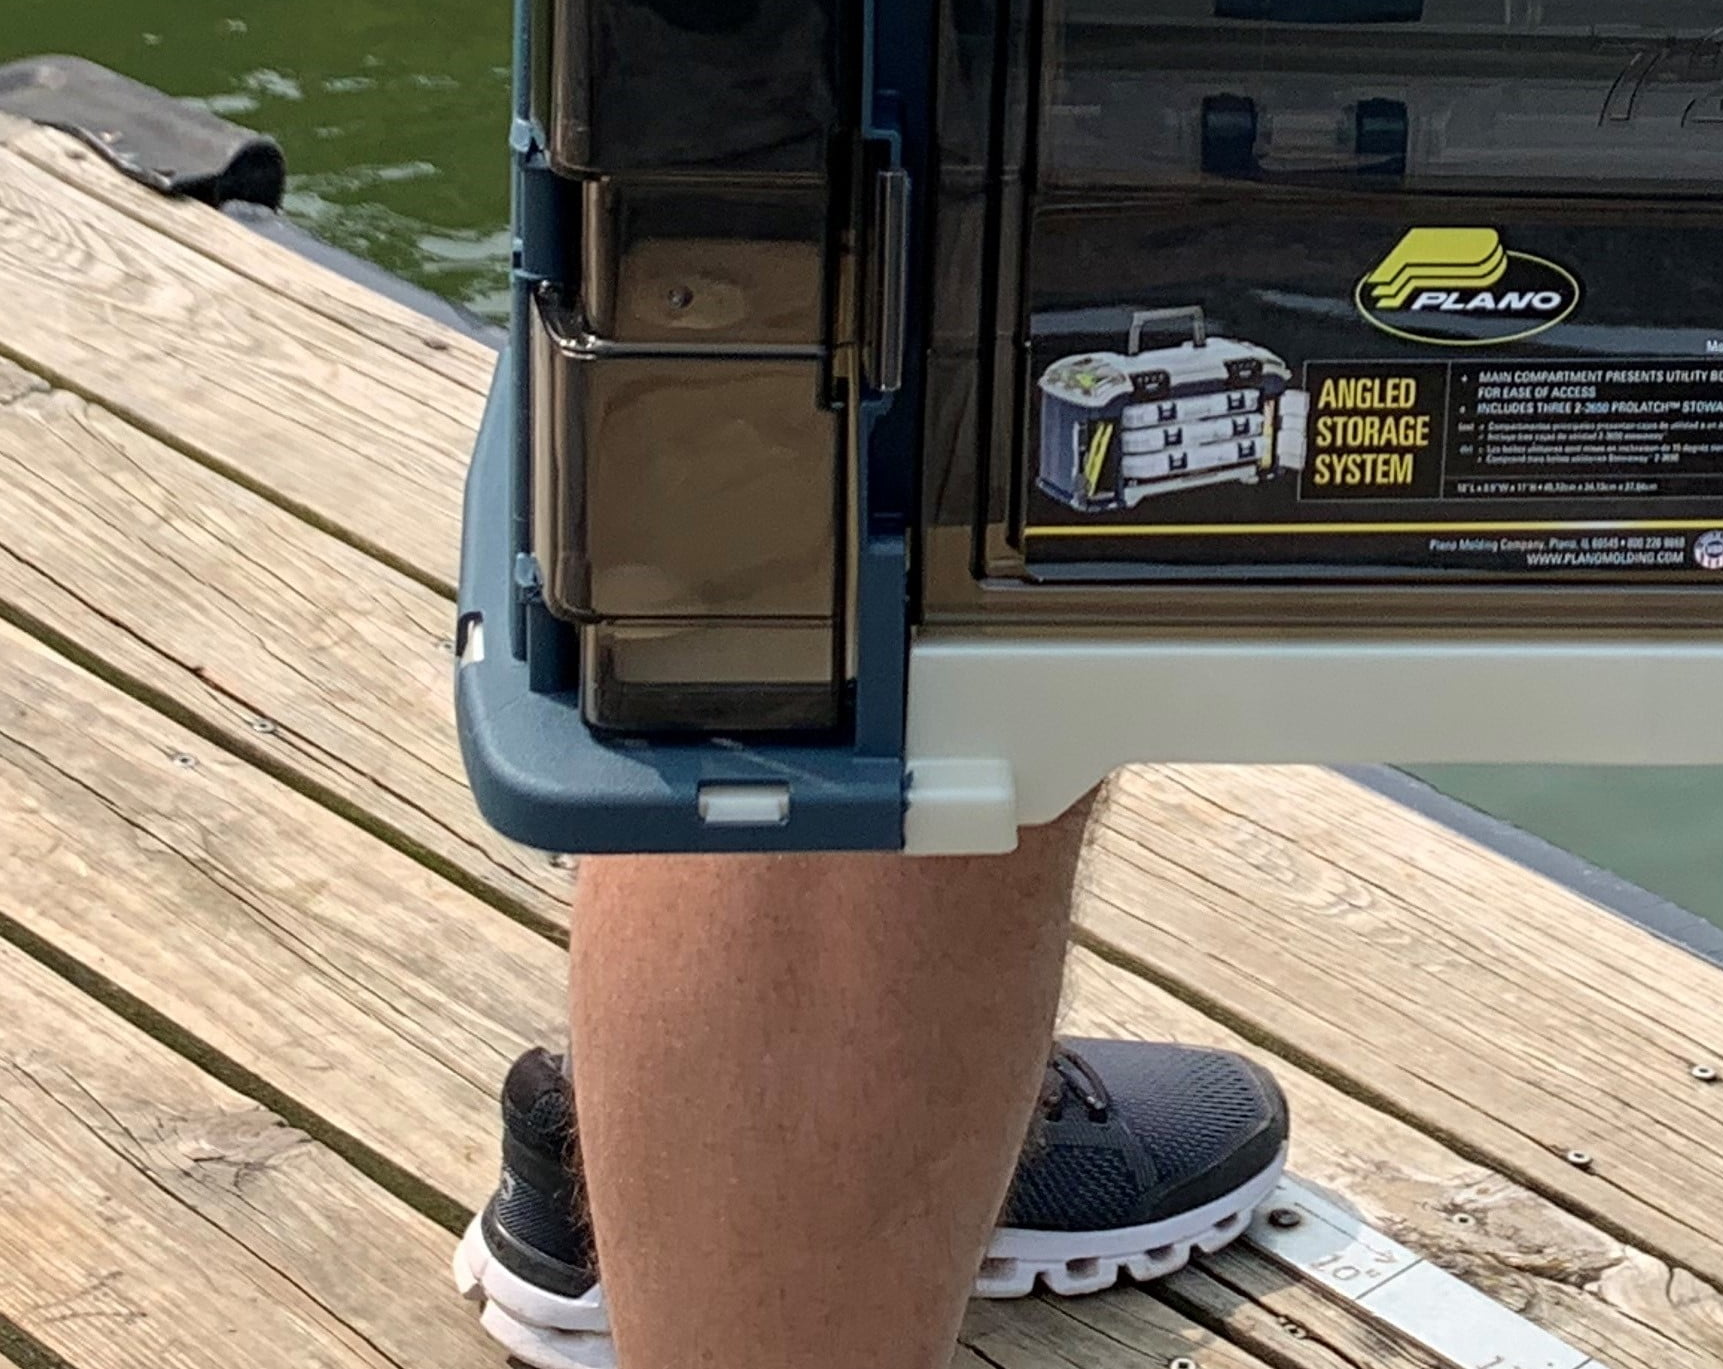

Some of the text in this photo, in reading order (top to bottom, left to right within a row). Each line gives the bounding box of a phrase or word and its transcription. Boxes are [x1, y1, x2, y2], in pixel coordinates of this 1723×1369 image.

[1411, 291, 1562, 310] PLANO
[1478, 370, 1512, 383] MAIN
[1514, 370, 1602, 383] COMPARTMENT
[1605, 370, 1664, 383] PRESENTS
[1666, 370, 1708, 382] UTILITY
[1318, 377, 1417, 410] ANGLED
[1477, 385, 1597, 399] FOR EASE OF ACCESS
[1477, 401, 1534, 415] INCLUDES
[1536, 401, 1571, 414] THREE
[1316, 415, 1431, 447] STORAGE
[1314, 453, 1414, 486] SYSTEM
[1429, 538, 1457, 551] Plano
[1459, 538, 1498, 552] Molding
[1526, 551, 1684, 566] WWW.PLANOMOLDING.COM
